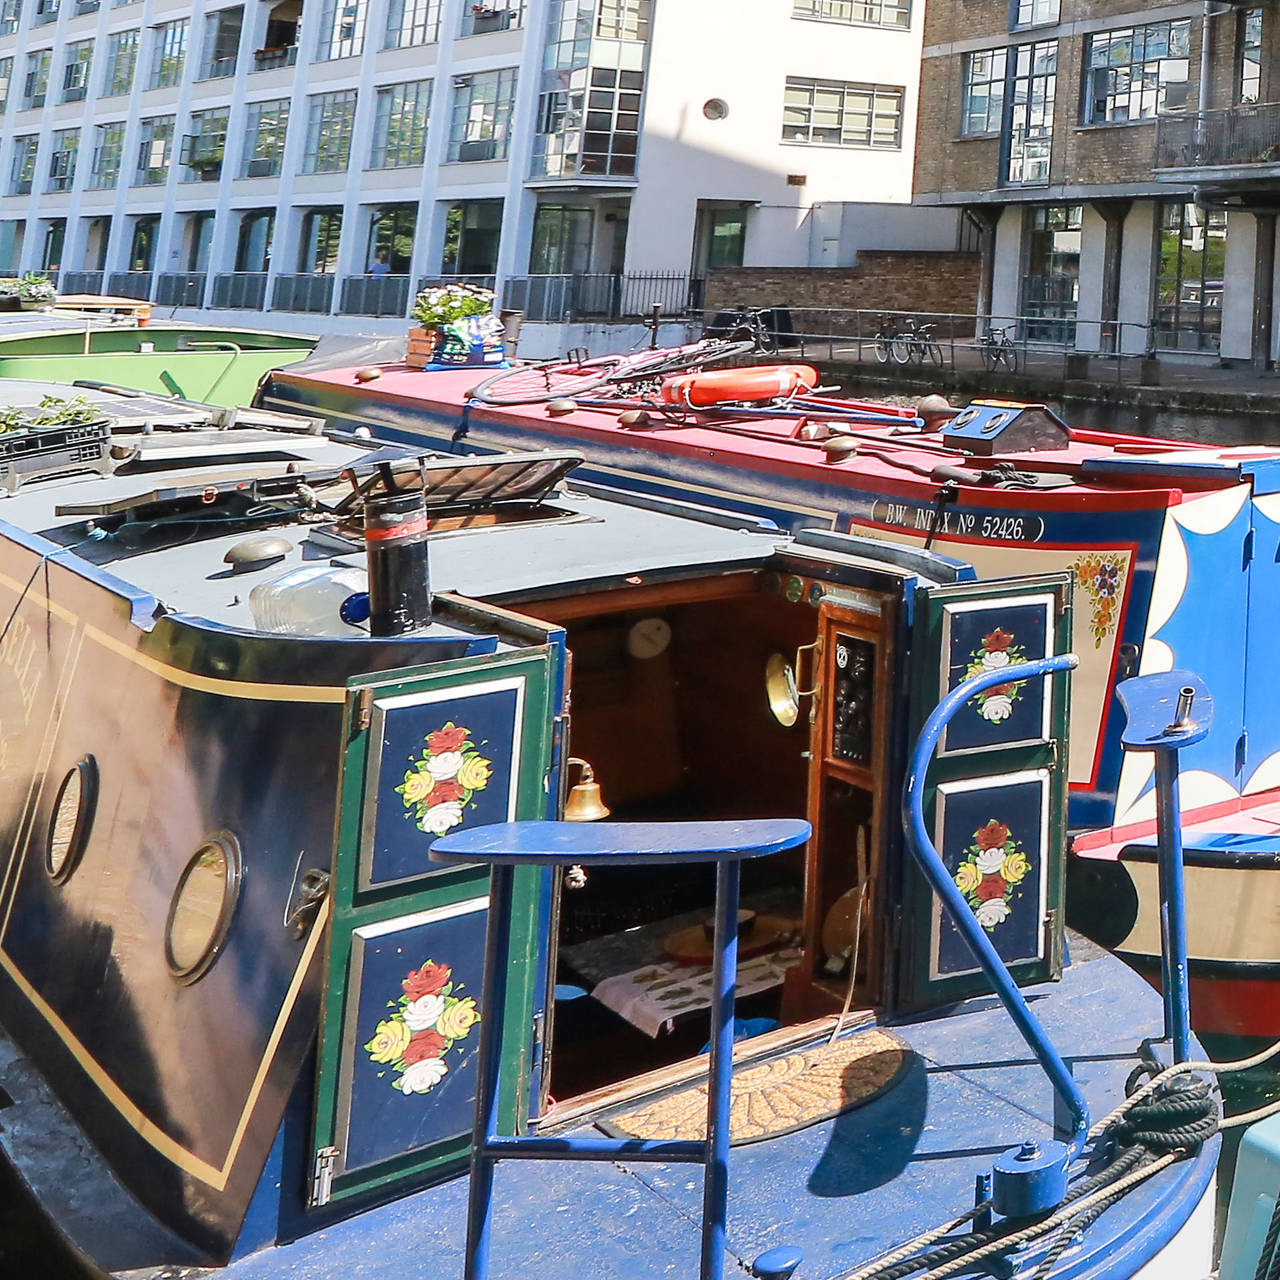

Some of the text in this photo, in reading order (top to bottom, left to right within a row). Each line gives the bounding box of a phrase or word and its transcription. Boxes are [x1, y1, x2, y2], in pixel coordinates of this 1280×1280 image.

[885, 503, 907, 526] B.W.
[914, 508, 951, 533] INDX
[981, 516, 1025, 540] 52426.
